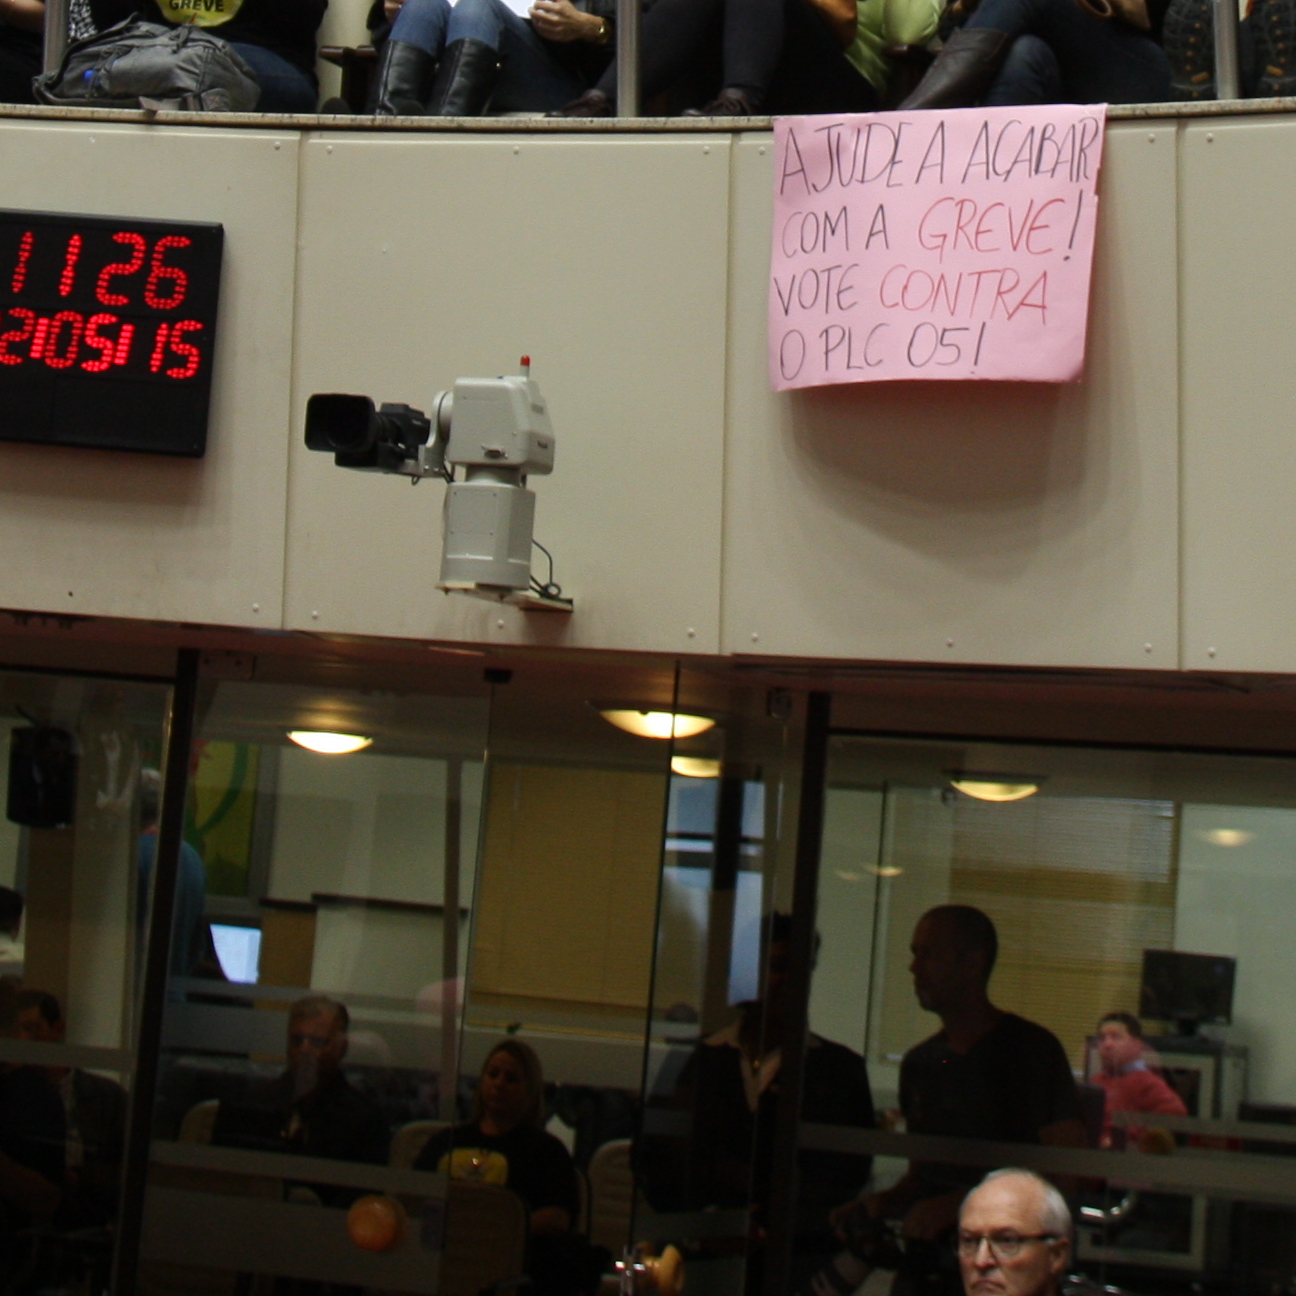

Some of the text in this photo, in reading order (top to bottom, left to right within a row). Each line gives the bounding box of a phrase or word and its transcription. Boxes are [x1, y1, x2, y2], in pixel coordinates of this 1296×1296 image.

[780, 116, 1100, 196] AJUDE A ACABAR
[781, 189, 1083, 264] COM A GREVE!
[773, 263, 1048, 325] VOTE CONTRA
[779, 321, 987, 381] O PLC 05!
